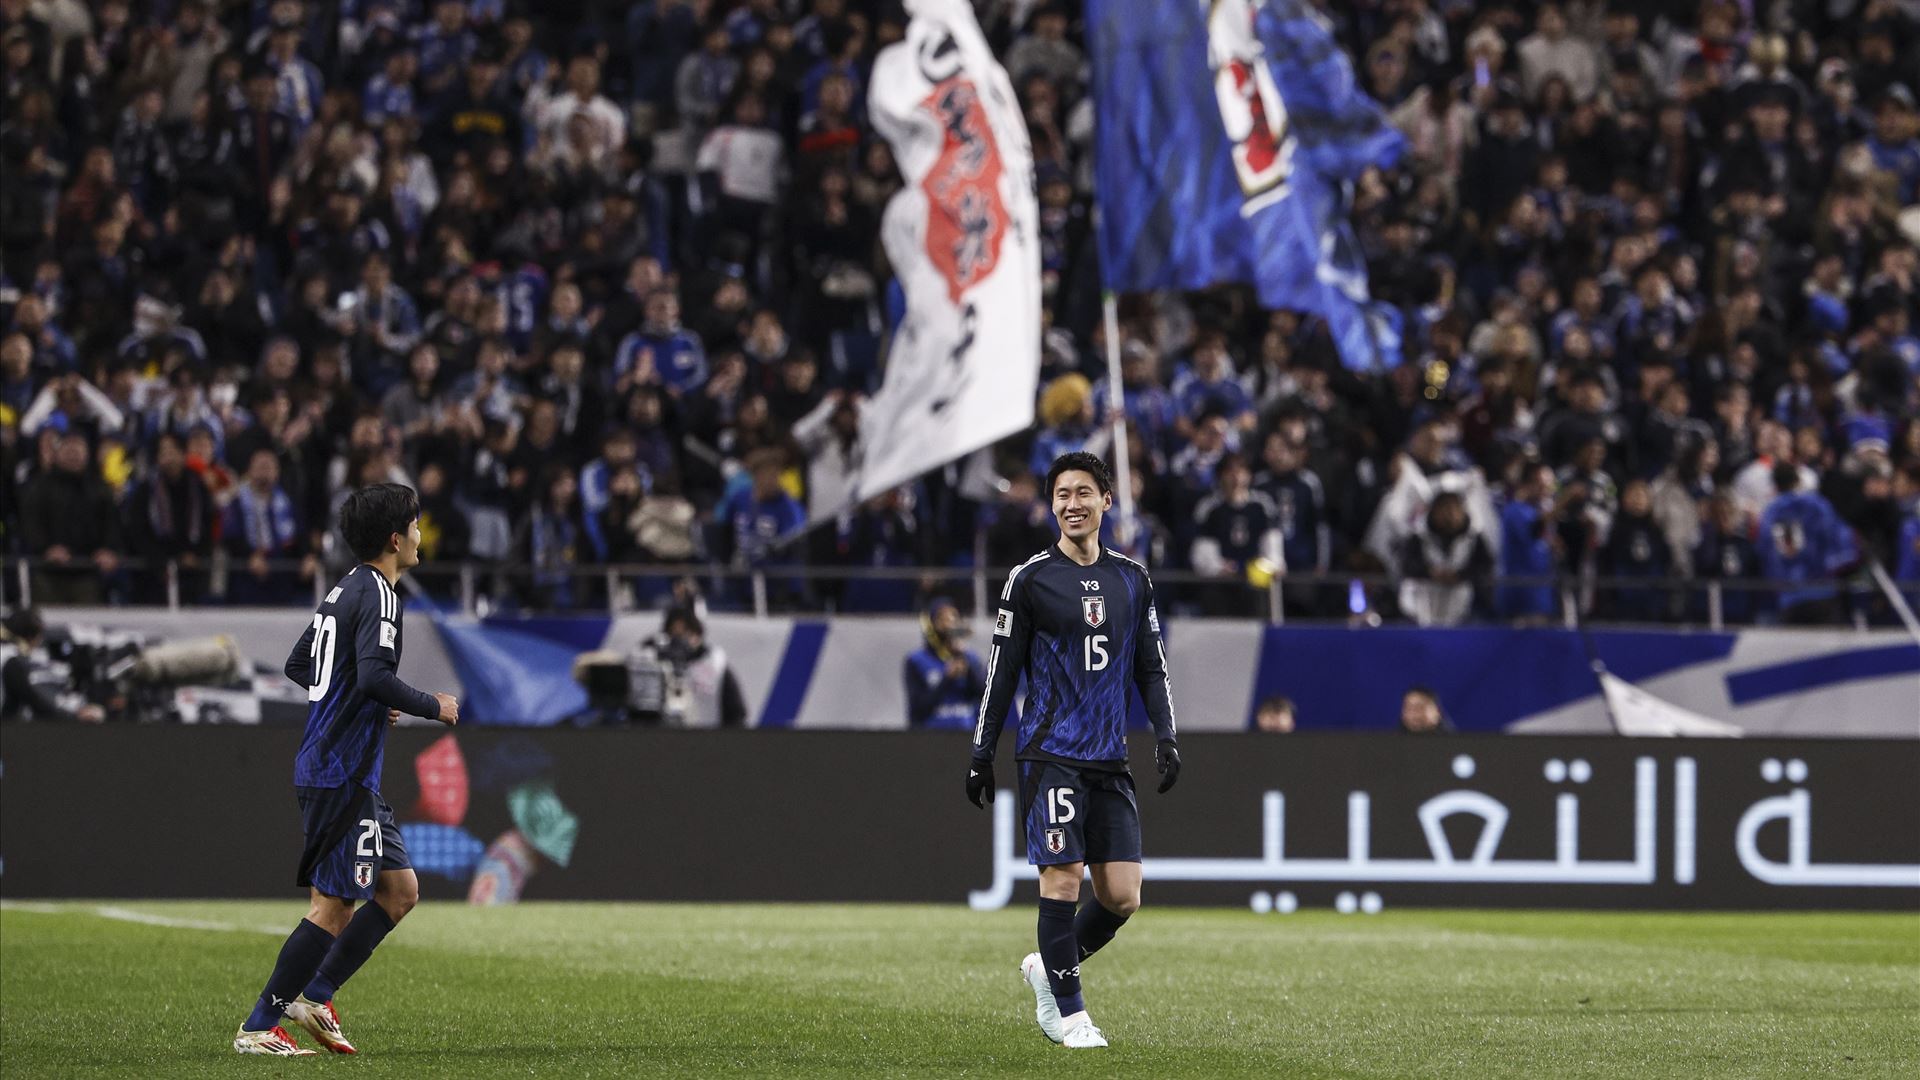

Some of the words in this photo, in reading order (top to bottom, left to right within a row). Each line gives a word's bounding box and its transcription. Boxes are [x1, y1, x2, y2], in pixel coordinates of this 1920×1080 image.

[1080, 580, 1100, 591] Y-3
[1084, 635, 1109, 671] 15
[1047, 787, 1076, 824] 15
[356, 818, 383, 857] 20
[1052, 965, 1080, 980] Y-3
